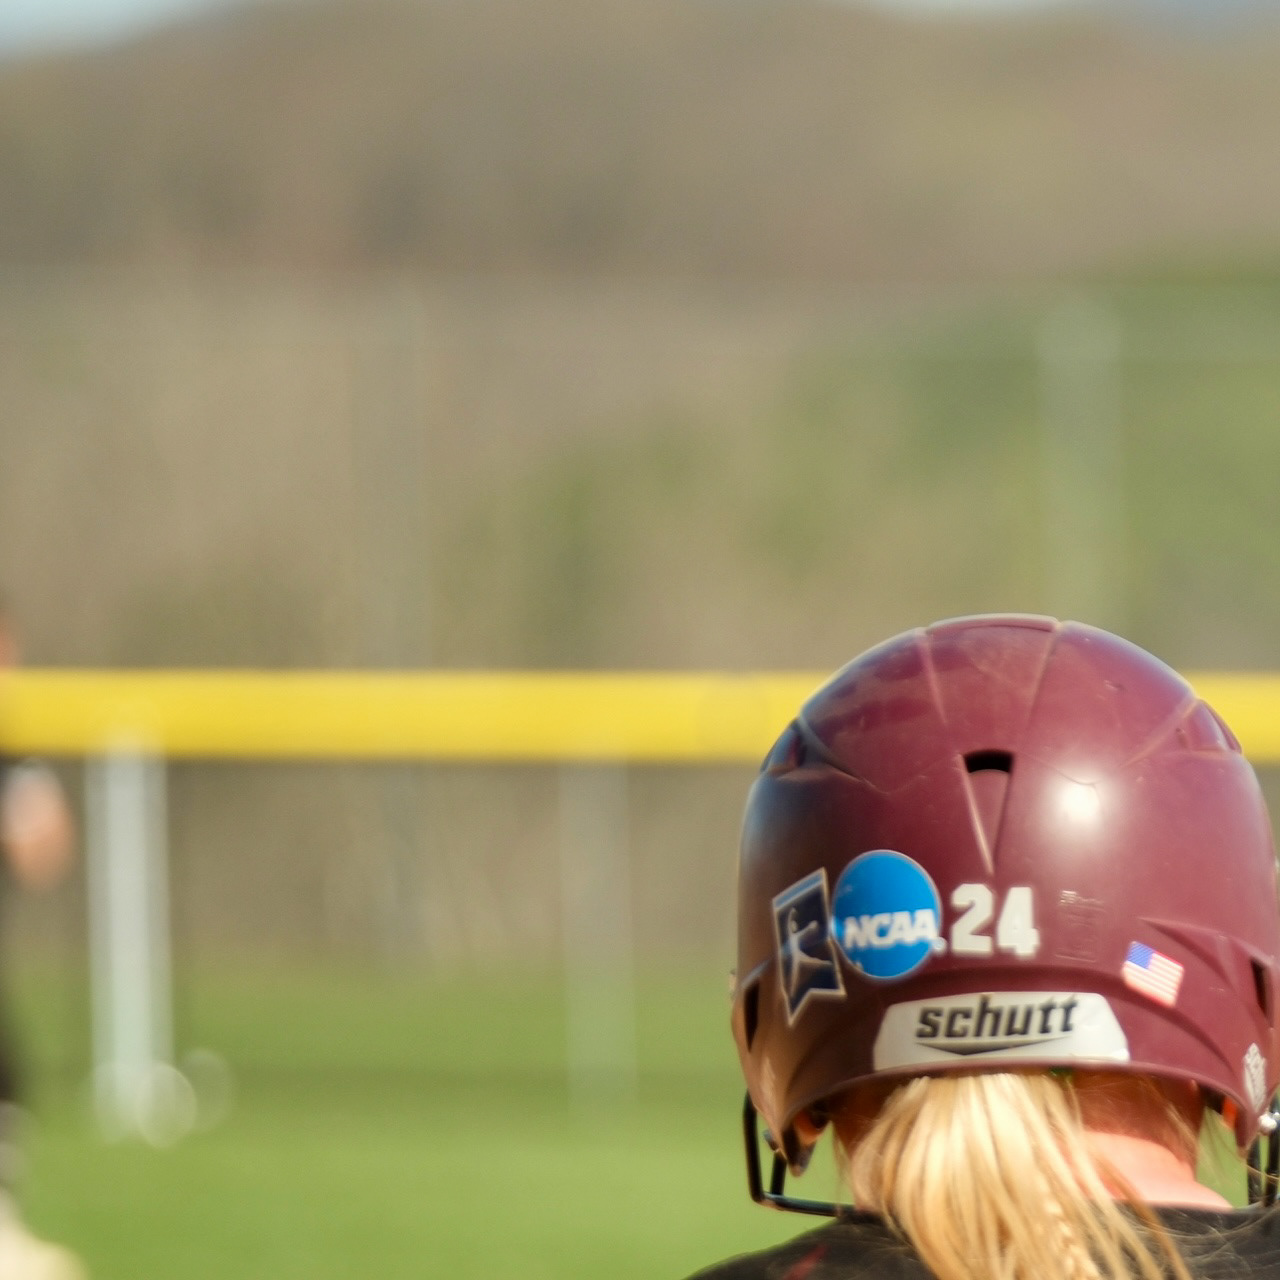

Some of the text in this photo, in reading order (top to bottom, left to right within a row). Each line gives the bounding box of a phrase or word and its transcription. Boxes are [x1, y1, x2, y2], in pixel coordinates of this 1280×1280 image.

[842, 909, 938, 948] NCAA
[951, 883, 1040, 957] 24
[915, 993, 1078, 1039] schutt
